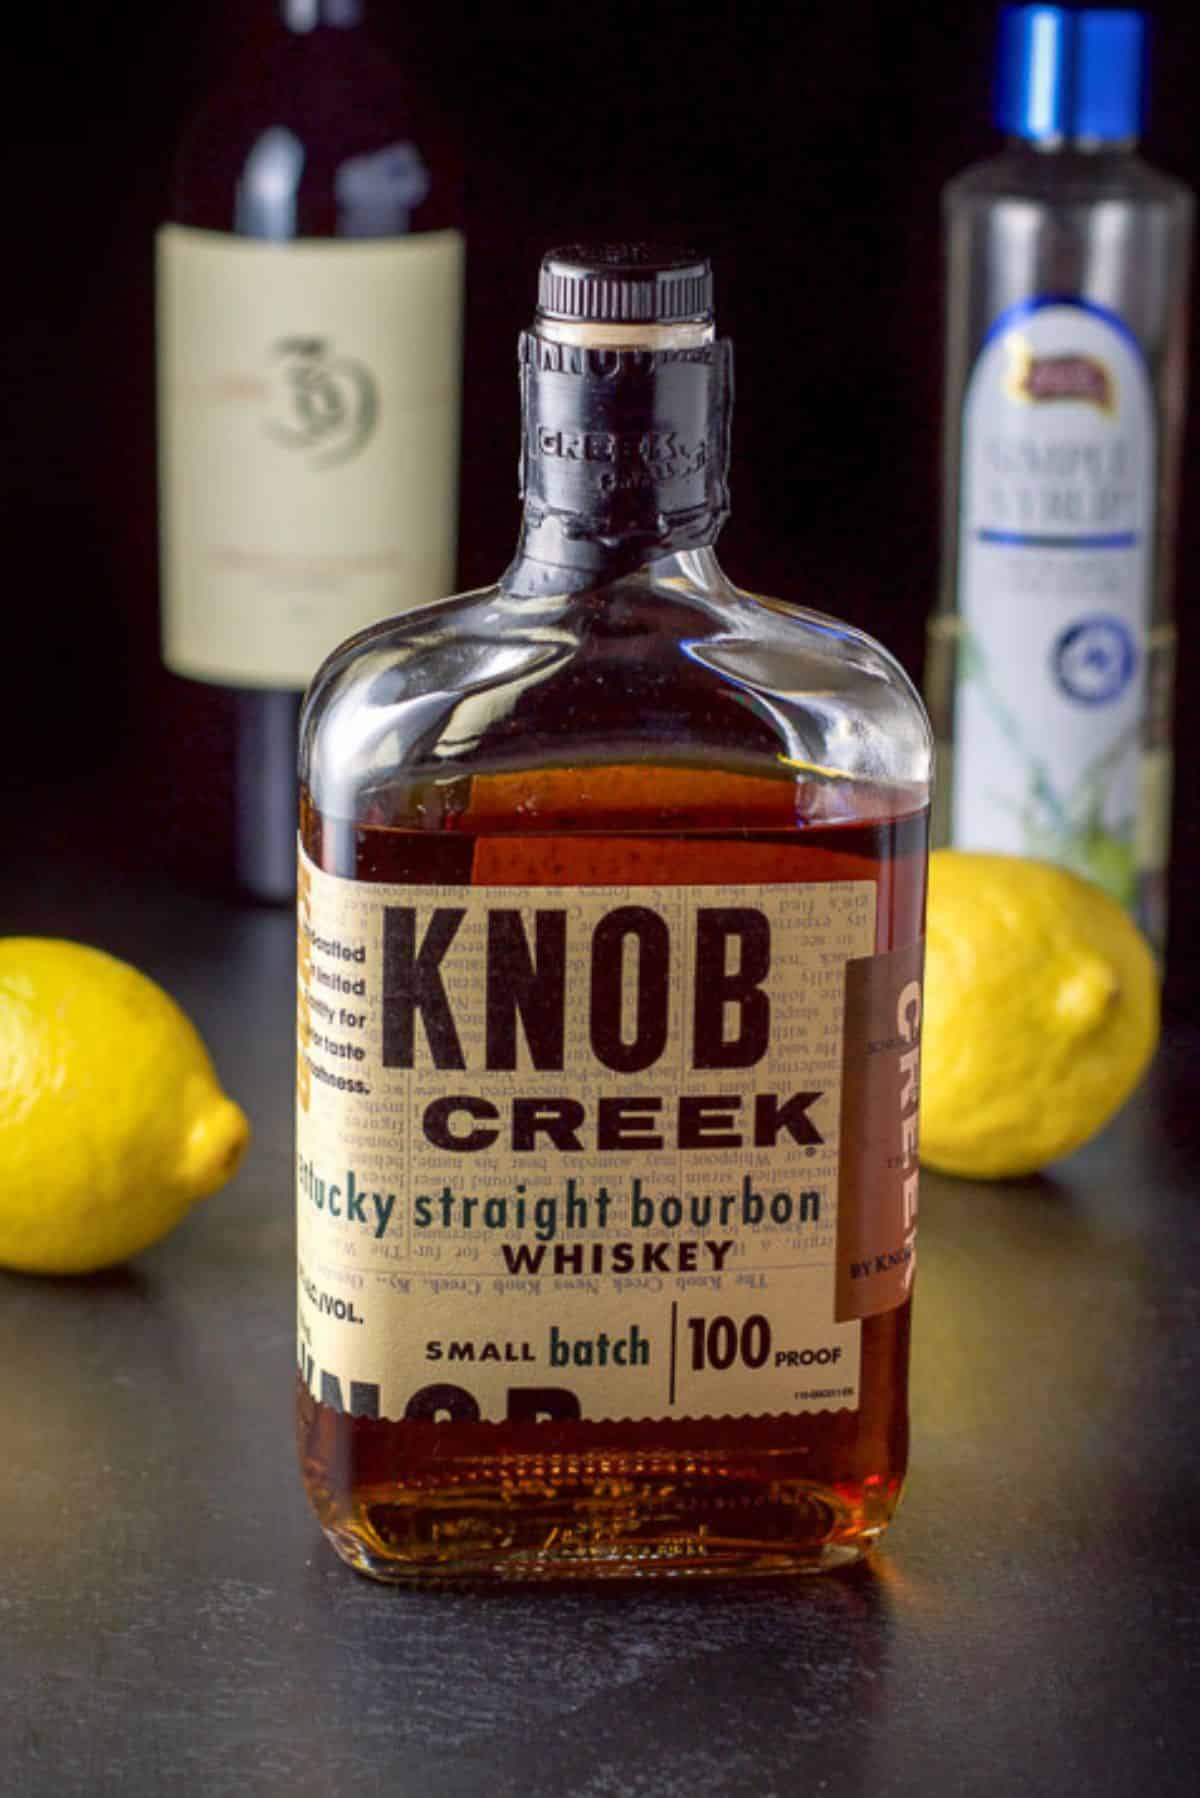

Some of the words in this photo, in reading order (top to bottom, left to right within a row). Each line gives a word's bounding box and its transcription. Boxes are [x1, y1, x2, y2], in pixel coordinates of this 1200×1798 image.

[382, 905, 771, 1073] KNOB
[339, 1008, 367, 1029] for
[324, 1037, 366, 1062] taste
[422, 1092, 825, 1152] CREEK
[413, 1177, 612, 1241] straight
[631, 1174, 821, 1229] bourbon
[501, 1239, 735, 1276] WHISKEY
[849, 1261, 872, 1280] BY
[425, 1340, 537, 1362] SMALL
[549, 1325, 650, 1368] batch
[687, 1313, 772, 1371] 100
[774, 1347, 842, 1368] PROOF
